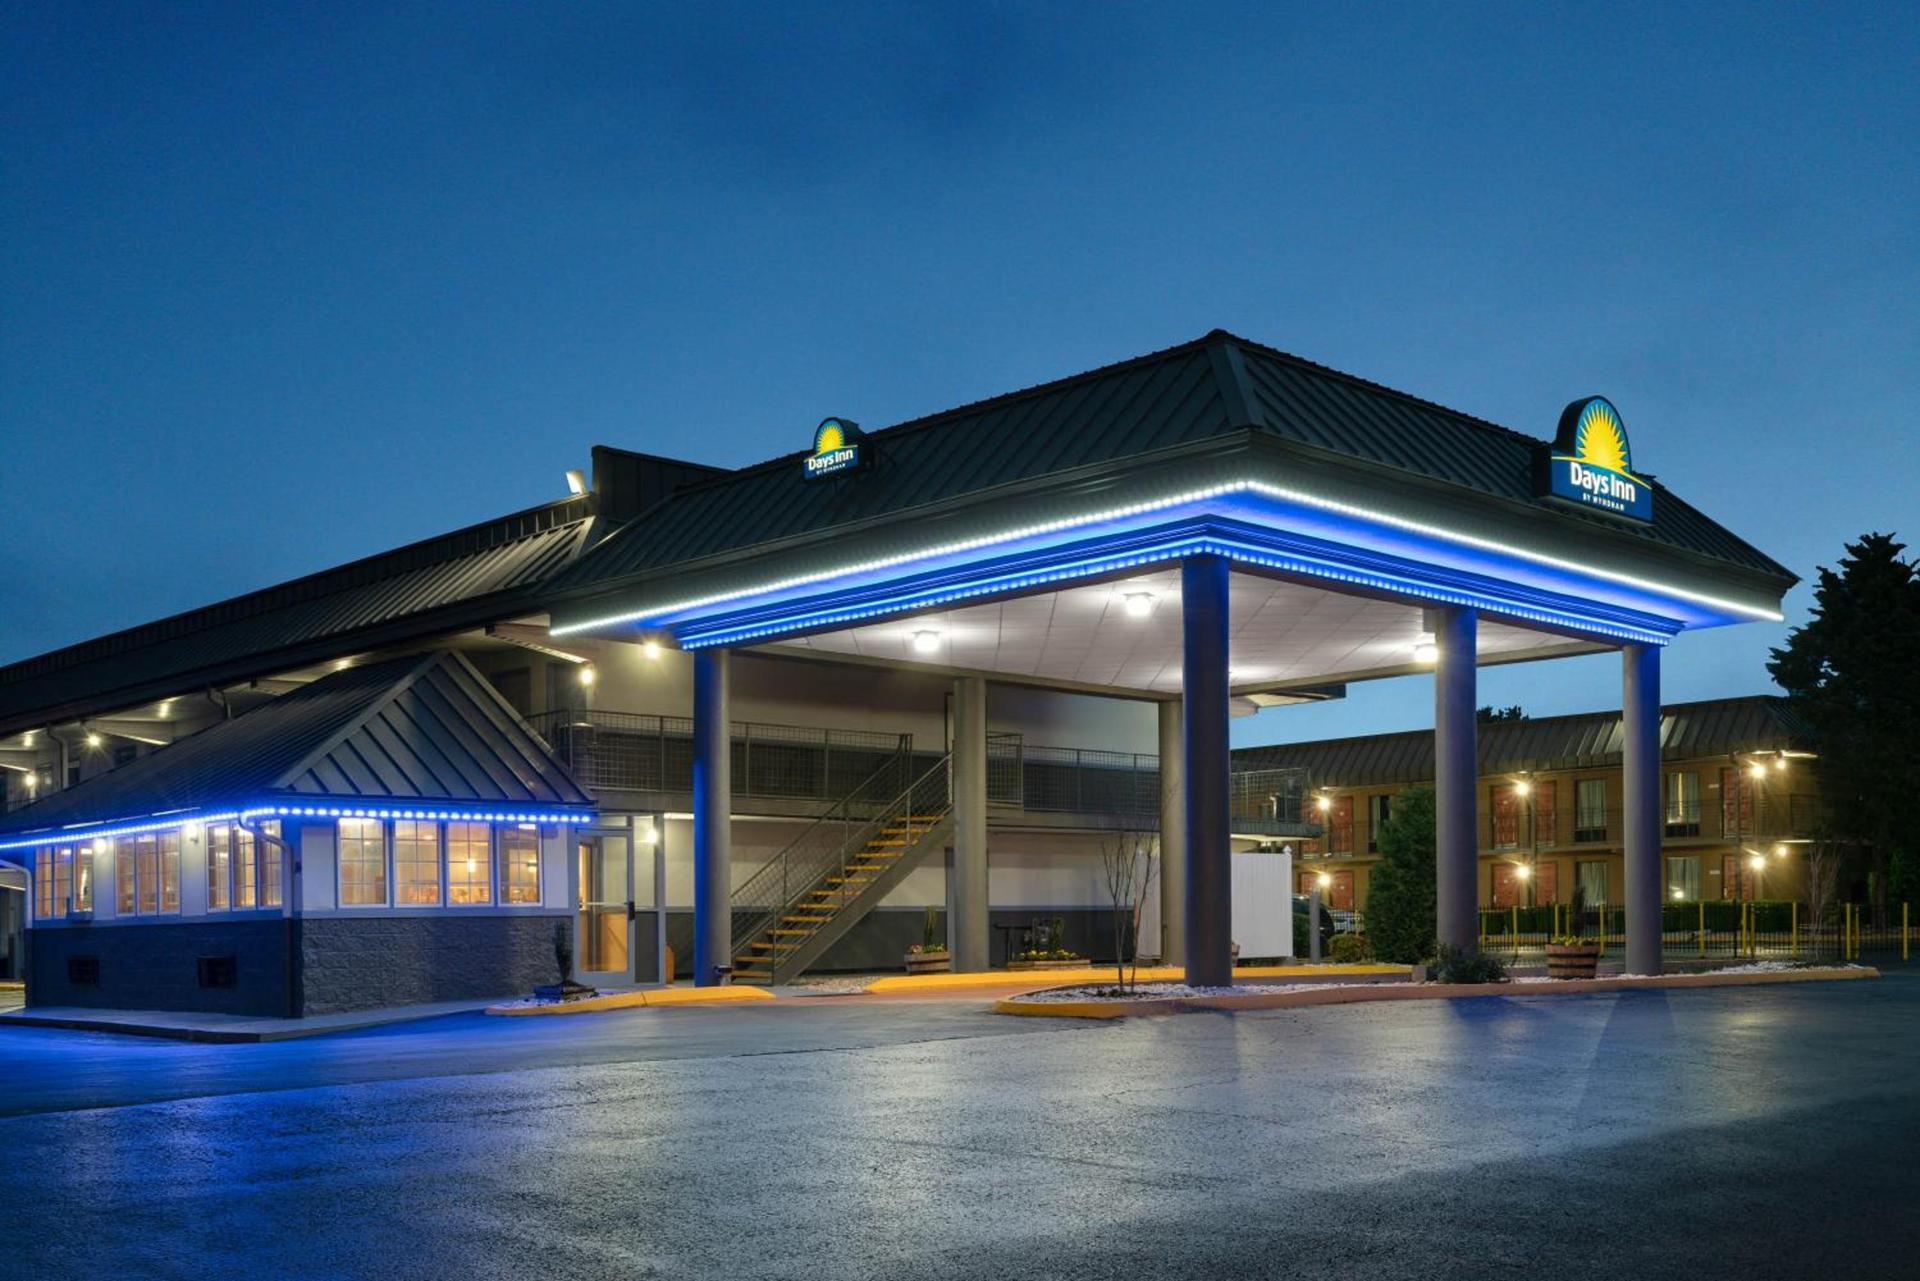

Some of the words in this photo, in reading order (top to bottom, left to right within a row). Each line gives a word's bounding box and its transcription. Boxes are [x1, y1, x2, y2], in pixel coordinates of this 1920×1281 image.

[808, 455, 834, 470] Days
[835, 449, 853, 462] Inn
[1570, 461, 1610, 494] Days
[1610, 474, 1636, 502] Inn
